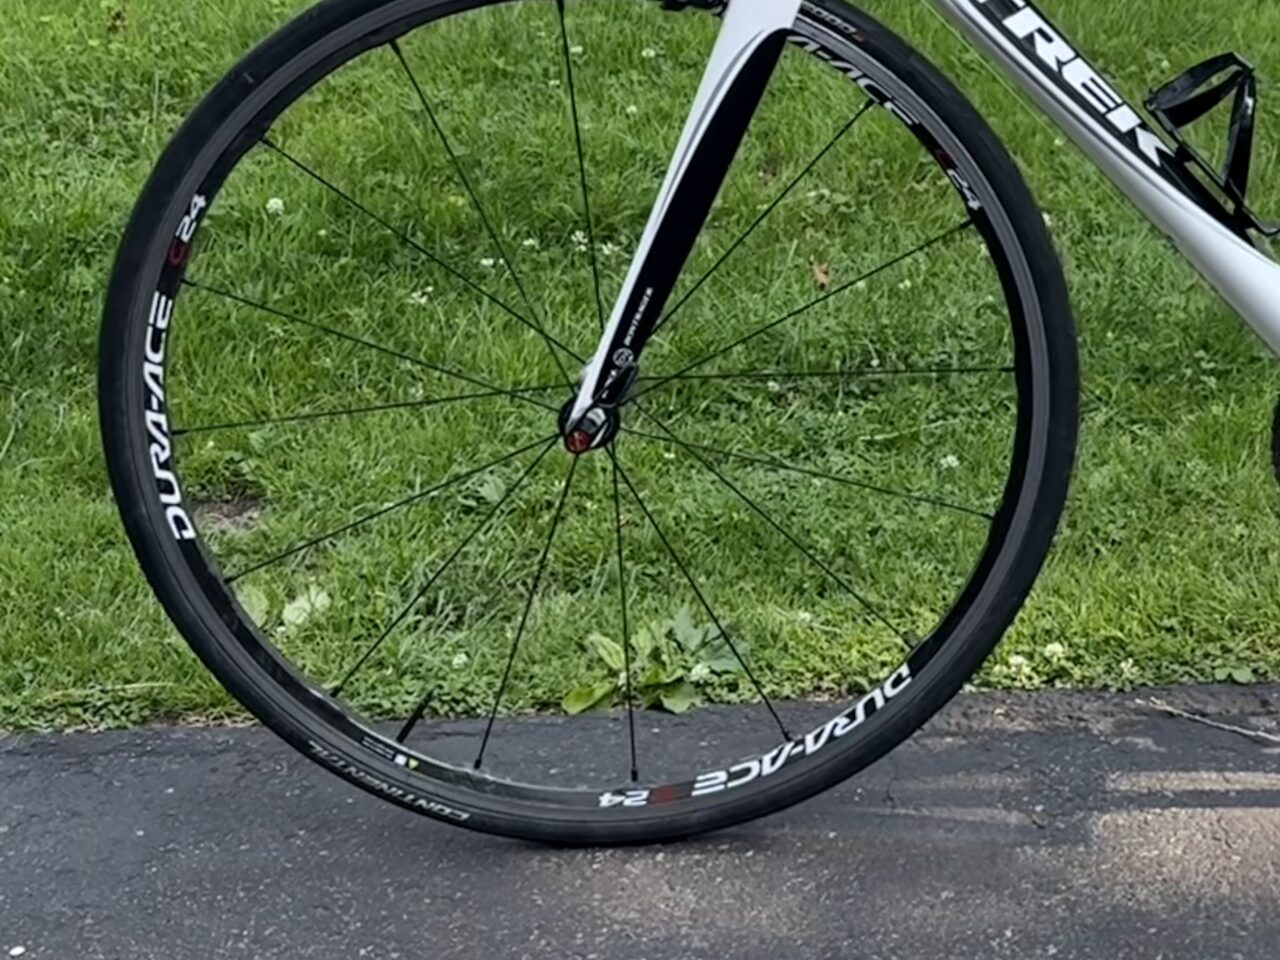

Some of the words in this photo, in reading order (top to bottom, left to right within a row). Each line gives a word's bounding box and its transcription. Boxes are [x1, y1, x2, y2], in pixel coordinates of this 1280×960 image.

[787, 34, 921, 125] A-ACE
[143, 291, 197, 540] DURA-ACE
[308, 740, 470, 821] CONTINENTAL
[692, 664, 912, 797] DURA-ACE
